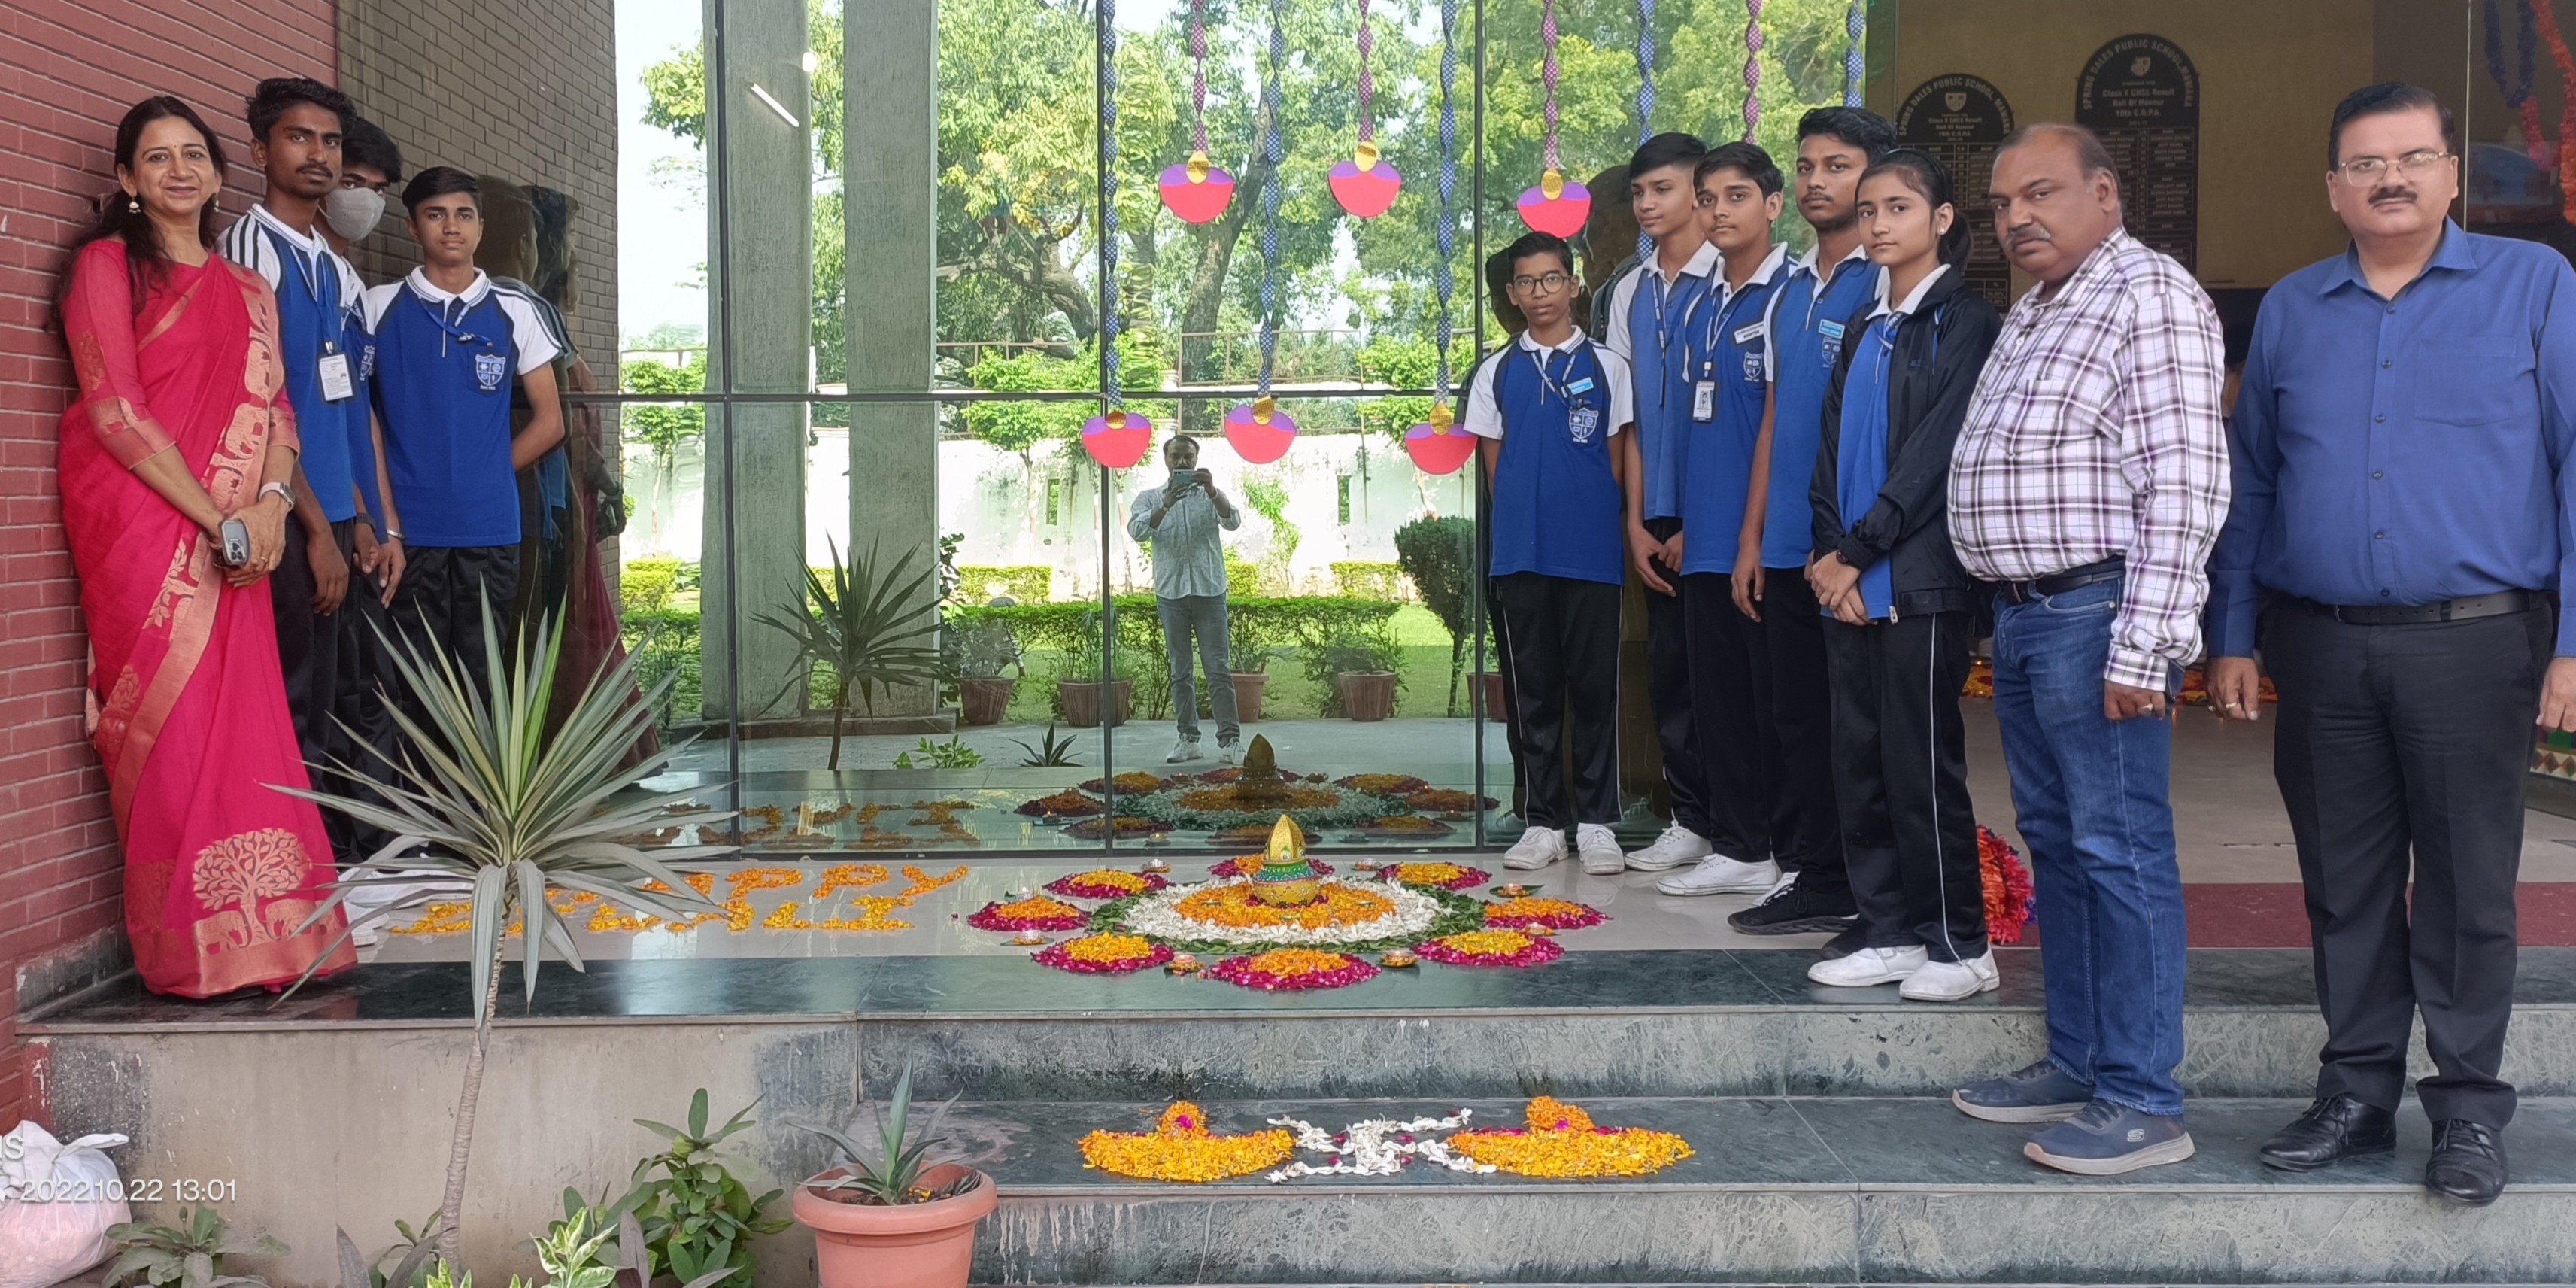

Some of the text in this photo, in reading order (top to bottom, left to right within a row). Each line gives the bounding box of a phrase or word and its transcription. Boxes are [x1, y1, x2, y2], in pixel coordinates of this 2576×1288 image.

[1899, 106, 1914, 136] SPRING
[1910, 85, 1932, 107] DALES
[1933, 77, 1964, 90] PUBLIC
[2082, 74, 2095, 110] SPRING
[2090, 48, 2114, 74] DALES
[2114, 38, 2149, 53] PUBLIC
